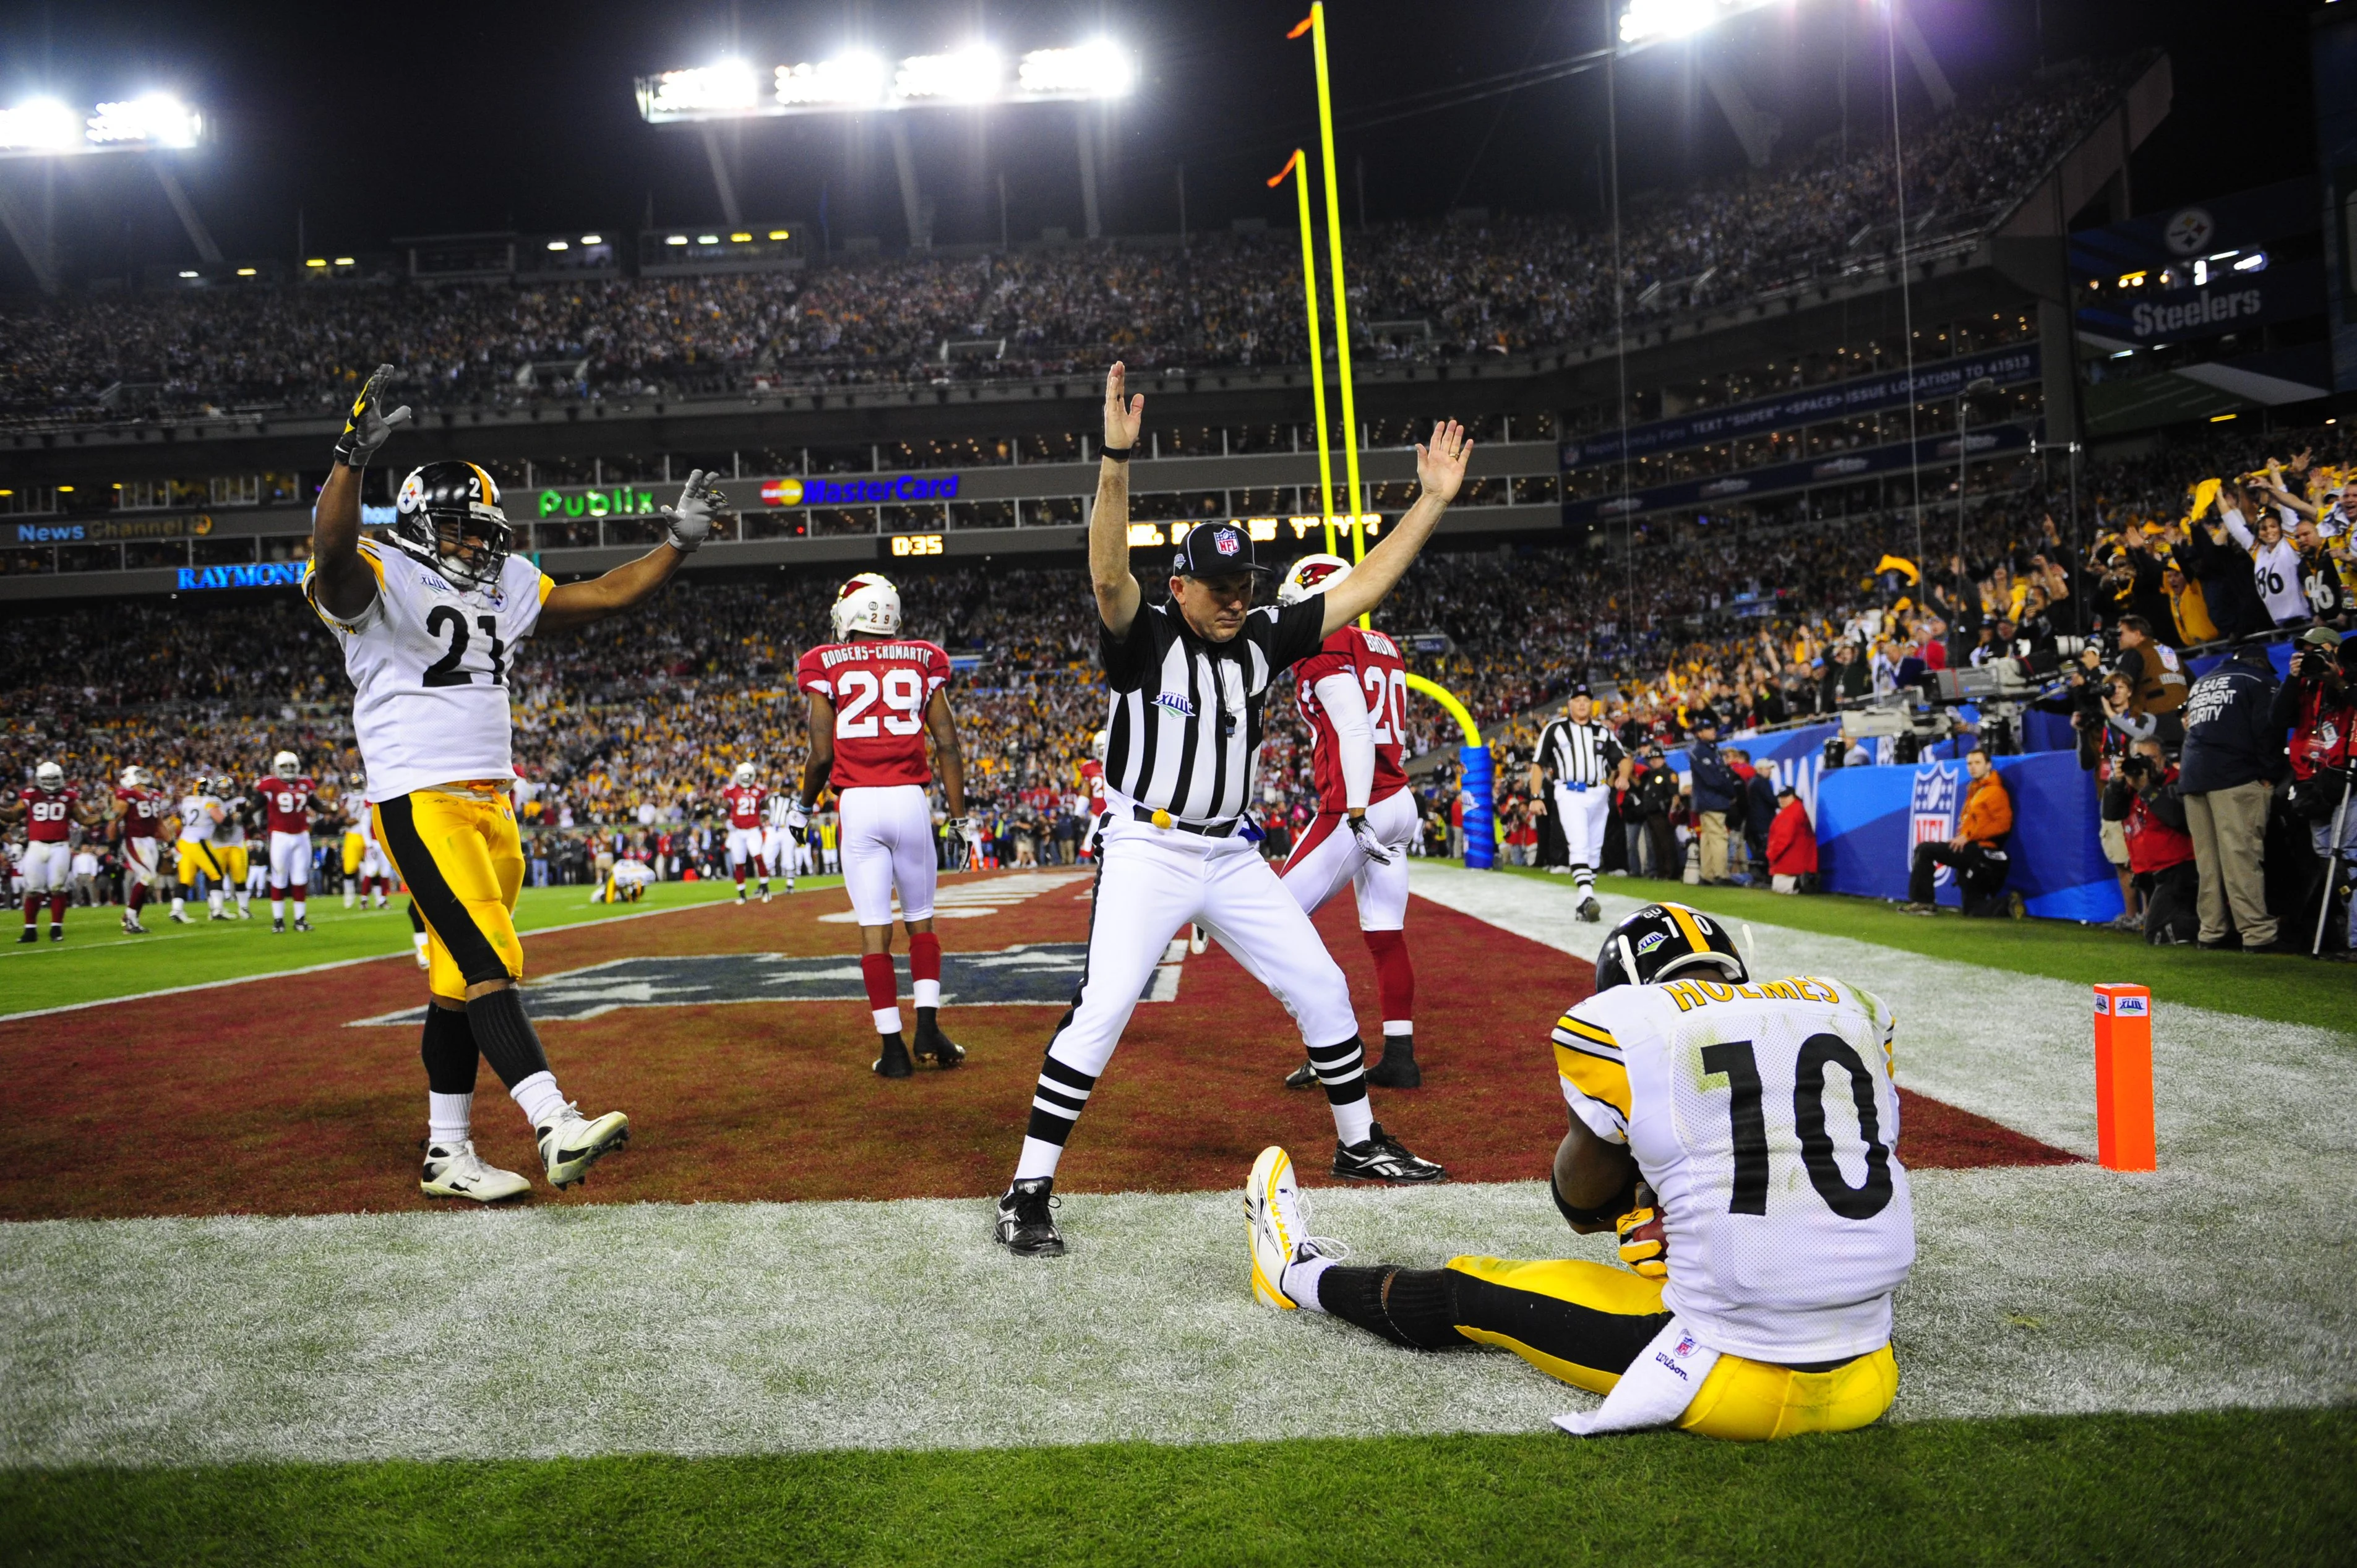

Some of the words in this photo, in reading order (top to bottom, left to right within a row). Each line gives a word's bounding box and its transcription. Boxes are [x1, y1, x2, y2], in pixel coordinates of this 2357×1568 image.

[2132, 289, 2262, 337] Steelers
[1691, 418, 1724, 434] TEXT
[1845, 384, 1887, 403] ISSUE
[1890, 369, 1962, 395] LOCATION
[1965, 364, 1985, 379] TO
[538, 486, 655, 518] Publix
[804, 474, 959, 504] MasterCard
[17, 525, 86, 542] News
[891, 534, 943, 557] 0:35
[1219, 539, 1238, 552] NFL
[423, 605, 506, 688] 21
[820, 645, 934, 670] RODGERS-CROMARTIE
[836, 668, 923, 740] 29
[1156, 694, 1193, 715] XLIII
[1363, 665, 1407, 746] 20
[32, 802, 66, 822] 90
[277, 792, 307, 813] 97
[736, 796, 757, 816] 21
[1642, 907, 1662, 919] GU
[1660, 975, 1840, 1013] HOLMES
[1700, 1032, 1894, 1220] 10
[1655, 1352, 1688, 1381] Wilson
